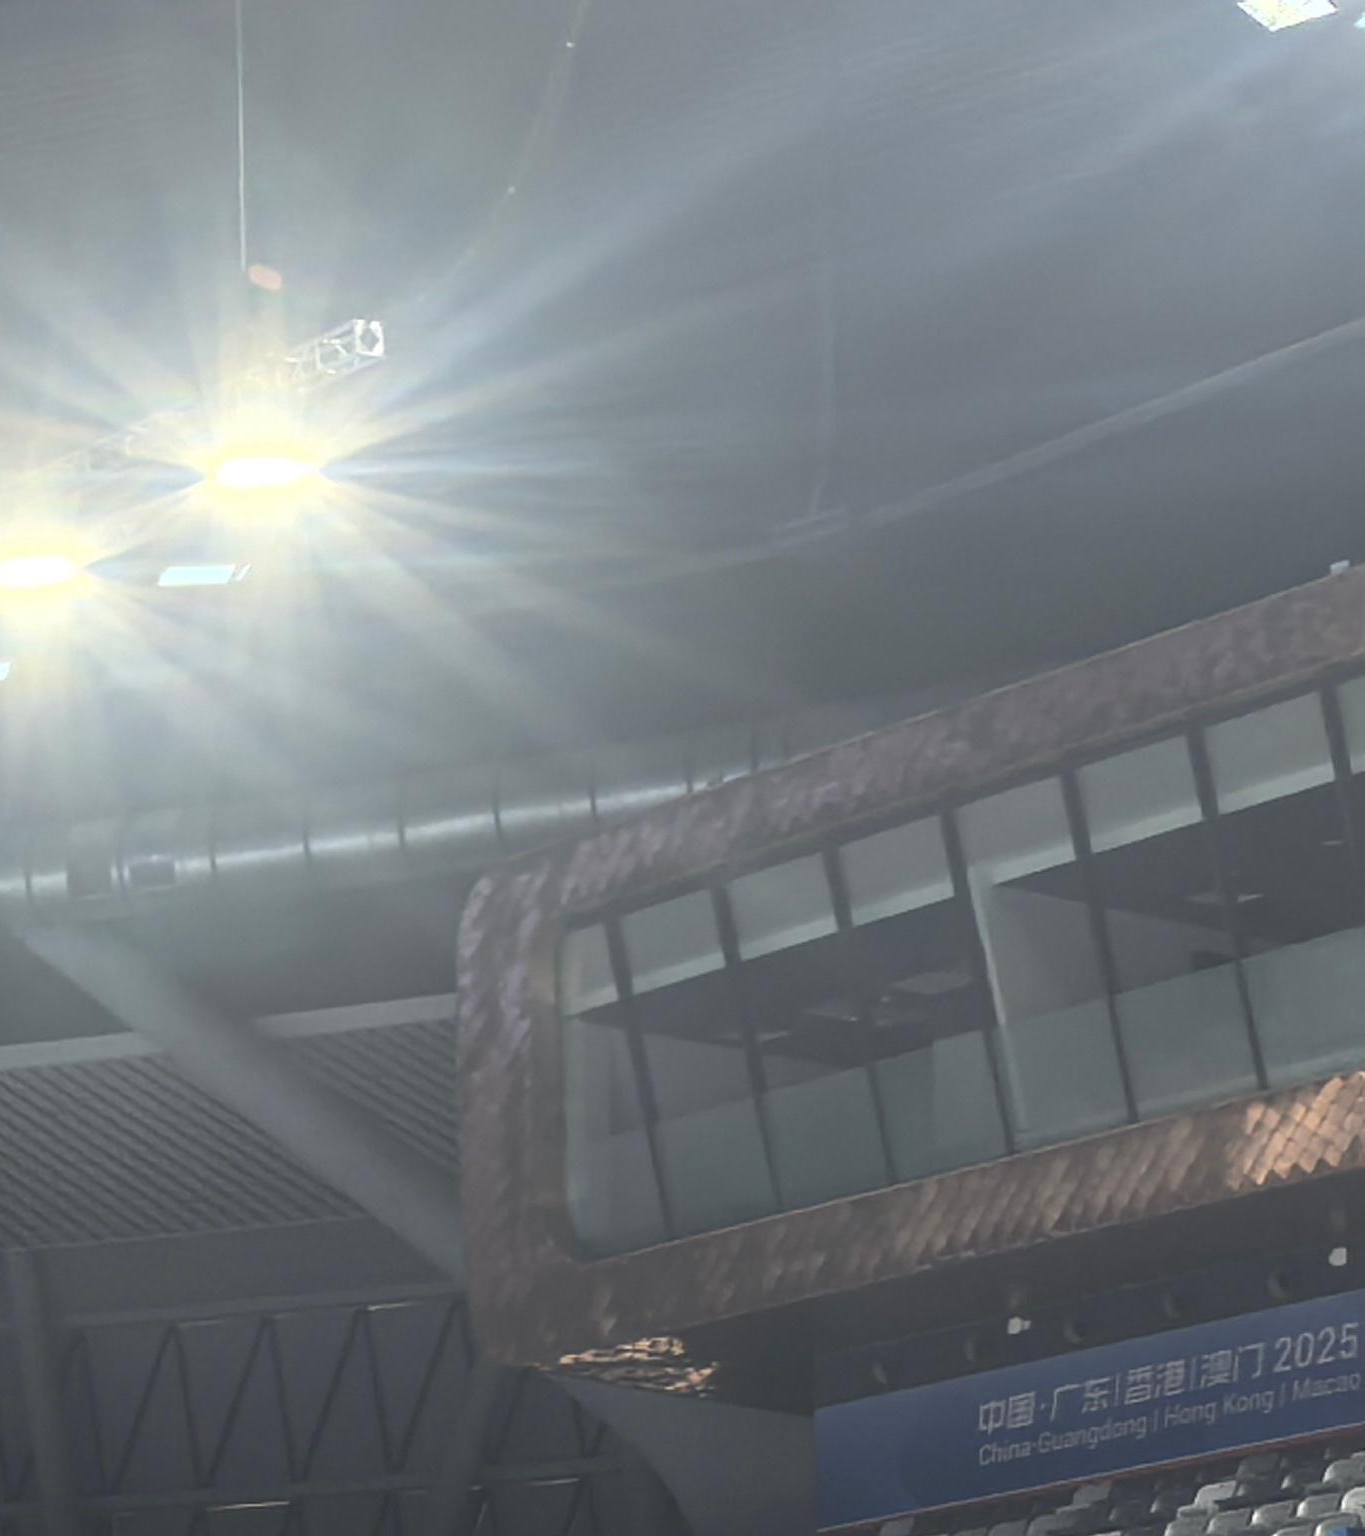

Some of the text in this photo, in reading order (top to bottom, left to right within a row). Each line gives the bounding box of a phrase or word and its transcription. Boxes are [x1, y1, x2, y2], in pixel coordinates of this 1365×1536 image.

[1273, 1322, 1359, 1373] 2025
[1165, 1402, 1216, 1428] Hong
[1224, 1390, 1274, 1415] Kong
